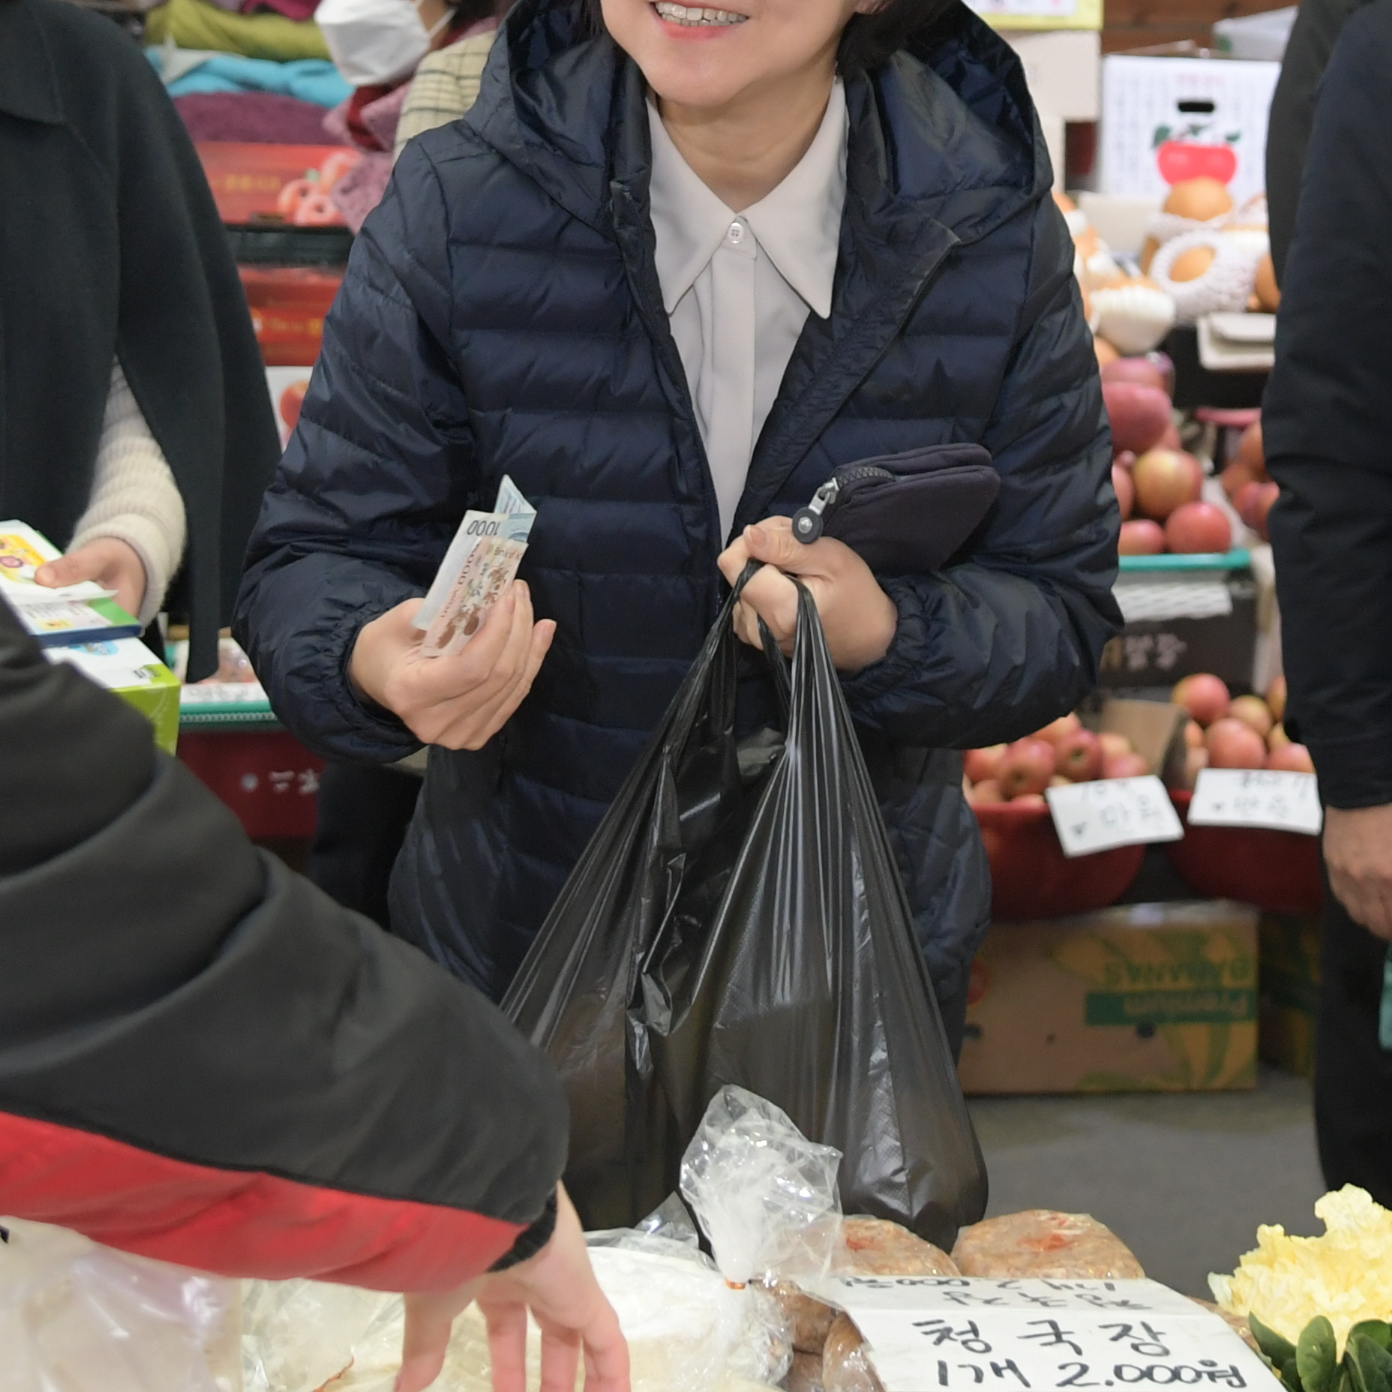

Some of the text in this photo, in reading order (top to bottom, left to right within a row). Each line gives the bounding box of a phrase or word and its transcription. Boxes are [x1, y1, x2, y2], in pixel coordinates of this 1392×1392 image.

[466, 519, 501, 536] 1000
[1123, 991, 1249, 1018] Premium
[936, 1358, 1032, 1389] 1개
